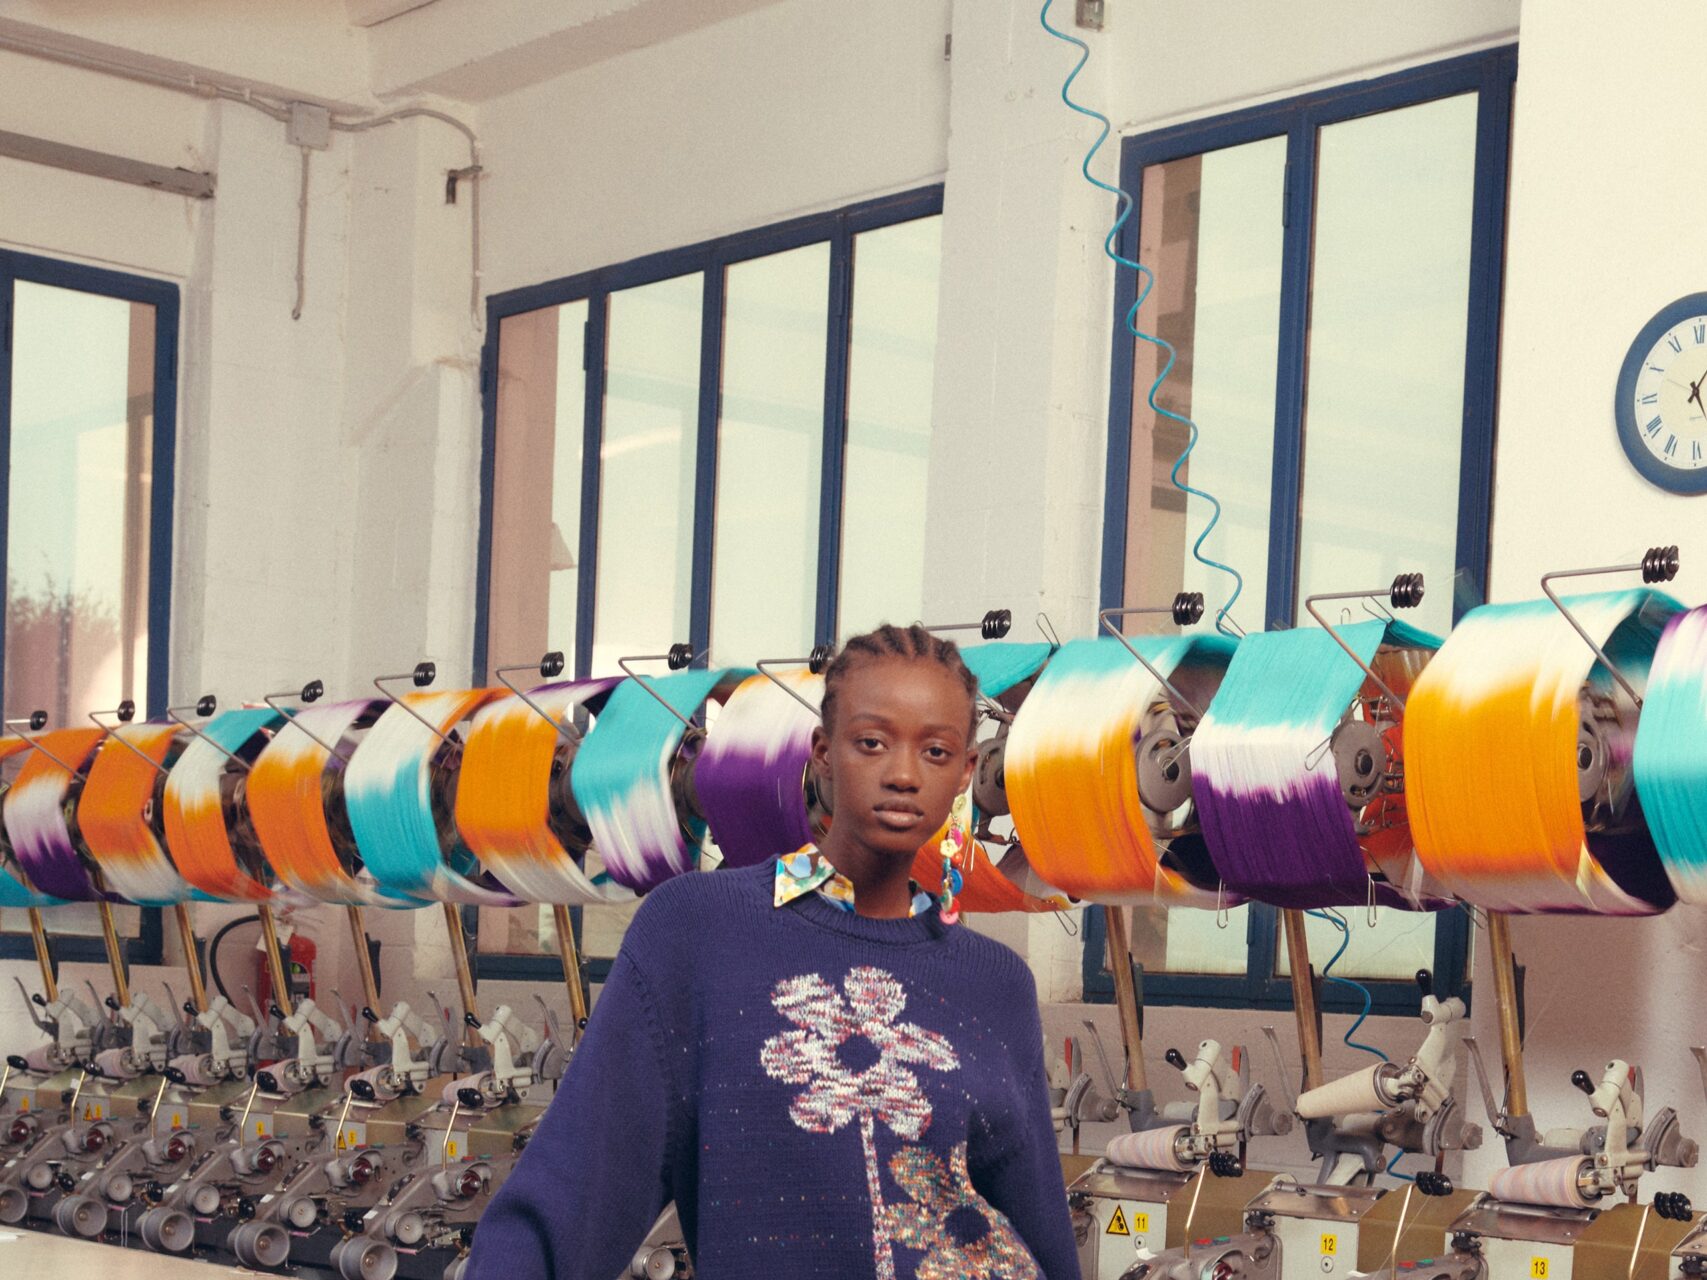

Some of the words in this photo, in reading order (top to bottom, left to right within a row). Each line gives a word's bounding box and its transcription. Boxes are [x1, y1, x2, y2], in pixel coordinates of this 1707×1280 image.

[1137, 1216, 1146, 1229] 11
[1323, 1237, 1333, 1251] 12
[1534, 1261, 1546, 1275] 13
